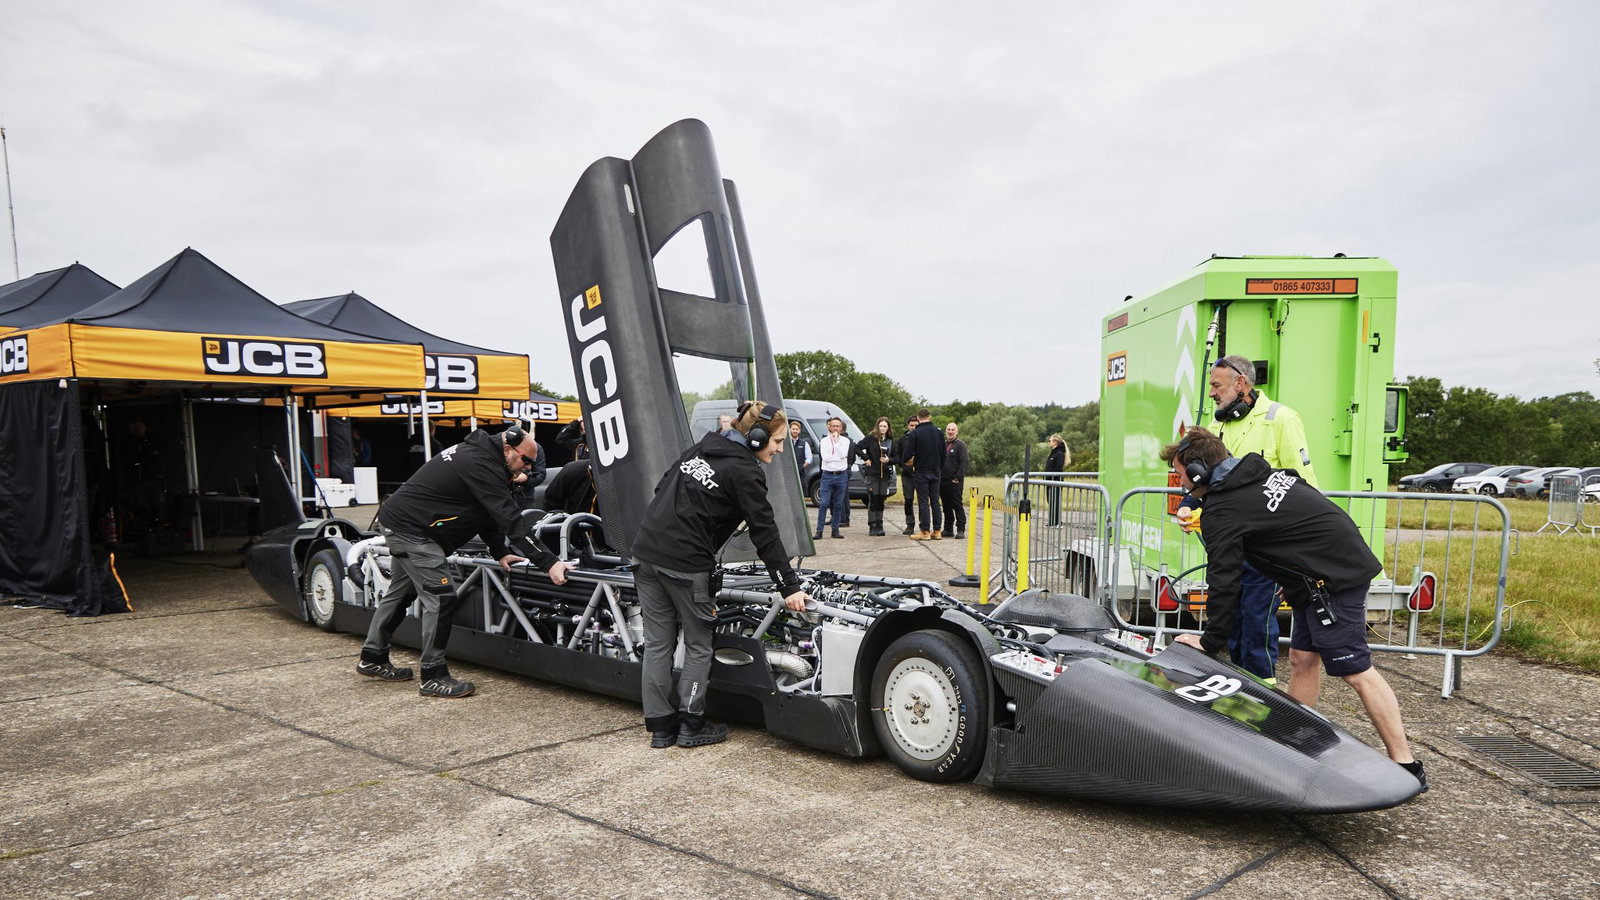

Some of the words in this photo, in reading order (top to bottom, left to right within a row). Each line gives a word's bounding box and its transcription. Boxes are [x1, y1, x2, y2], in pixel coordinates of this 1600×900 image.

[1273, 282, 1298, 291] 01865
[1300, 281, 1331, 291] 407333
[0, 338, 28, 373] CB
[206, 341, 325, 375] JCB
[1108, 357, 1126, 380] JCB
[571, 294, 629, 467] JCB
[503, 401, 557, 420] JCB
[1121, 518, 1162, 552] YDROGEN
[1175, 675, 1242, 703] CB
[938, 715, 967, 773] GOODYEAR
